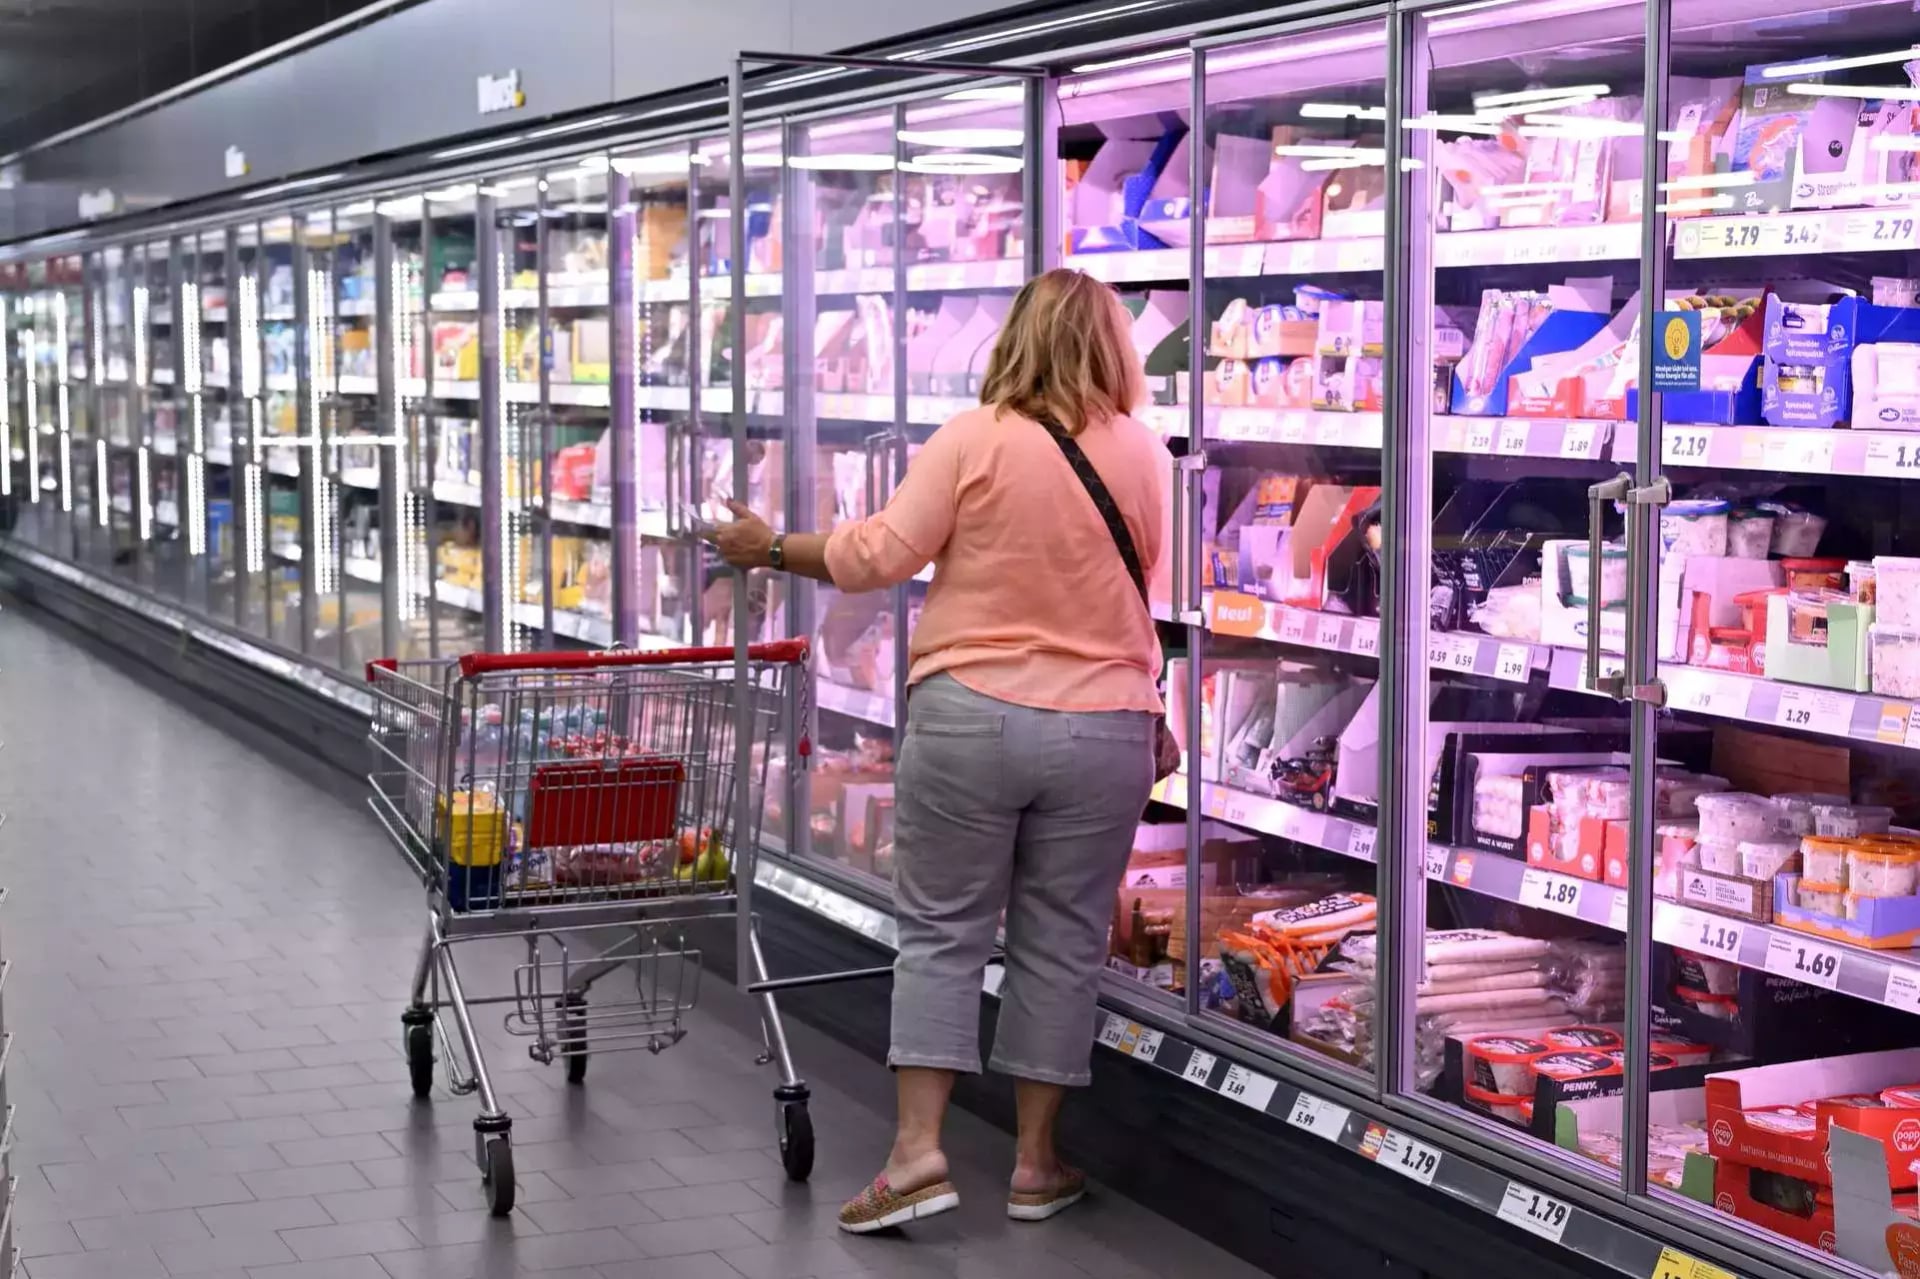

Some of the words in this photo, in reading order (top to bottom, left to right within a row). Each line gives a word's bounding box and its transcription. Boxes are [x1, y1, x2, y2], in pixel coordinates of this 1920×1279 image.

[1724, 226, 1760, 246] 3.79
[1873, 218, 1913, 239] 2.79
[1505, 437, 1524, 450] 1.89
[1569, 440, 1589, 452] 1.89
[1672, 436, 1707, 456] 2.19
[1217, 606, 1253, 621] Neu!
[1455, 654, 1472, 667] 0.59
[1503, 662, 1522, 676] 1.99
[1785, 708, 1810, 724] 1.29
[1354, 841, 1370, 854] 2.99
[1543, 881, 1577, 904] 1.89
[1700, 924, 1737, 951] 1.19
[1795, 947, 1836, 977] 1.69
[1227, 1081, 1246, 1096] 3.69
[1296, 1111, 1315, 1126] 5.99
[1896, 1131, 1920, 1142] popp
[1401, 1145, 1436, 1174] 1.79
[1527, 1195, 1566, 1226] 1.79
